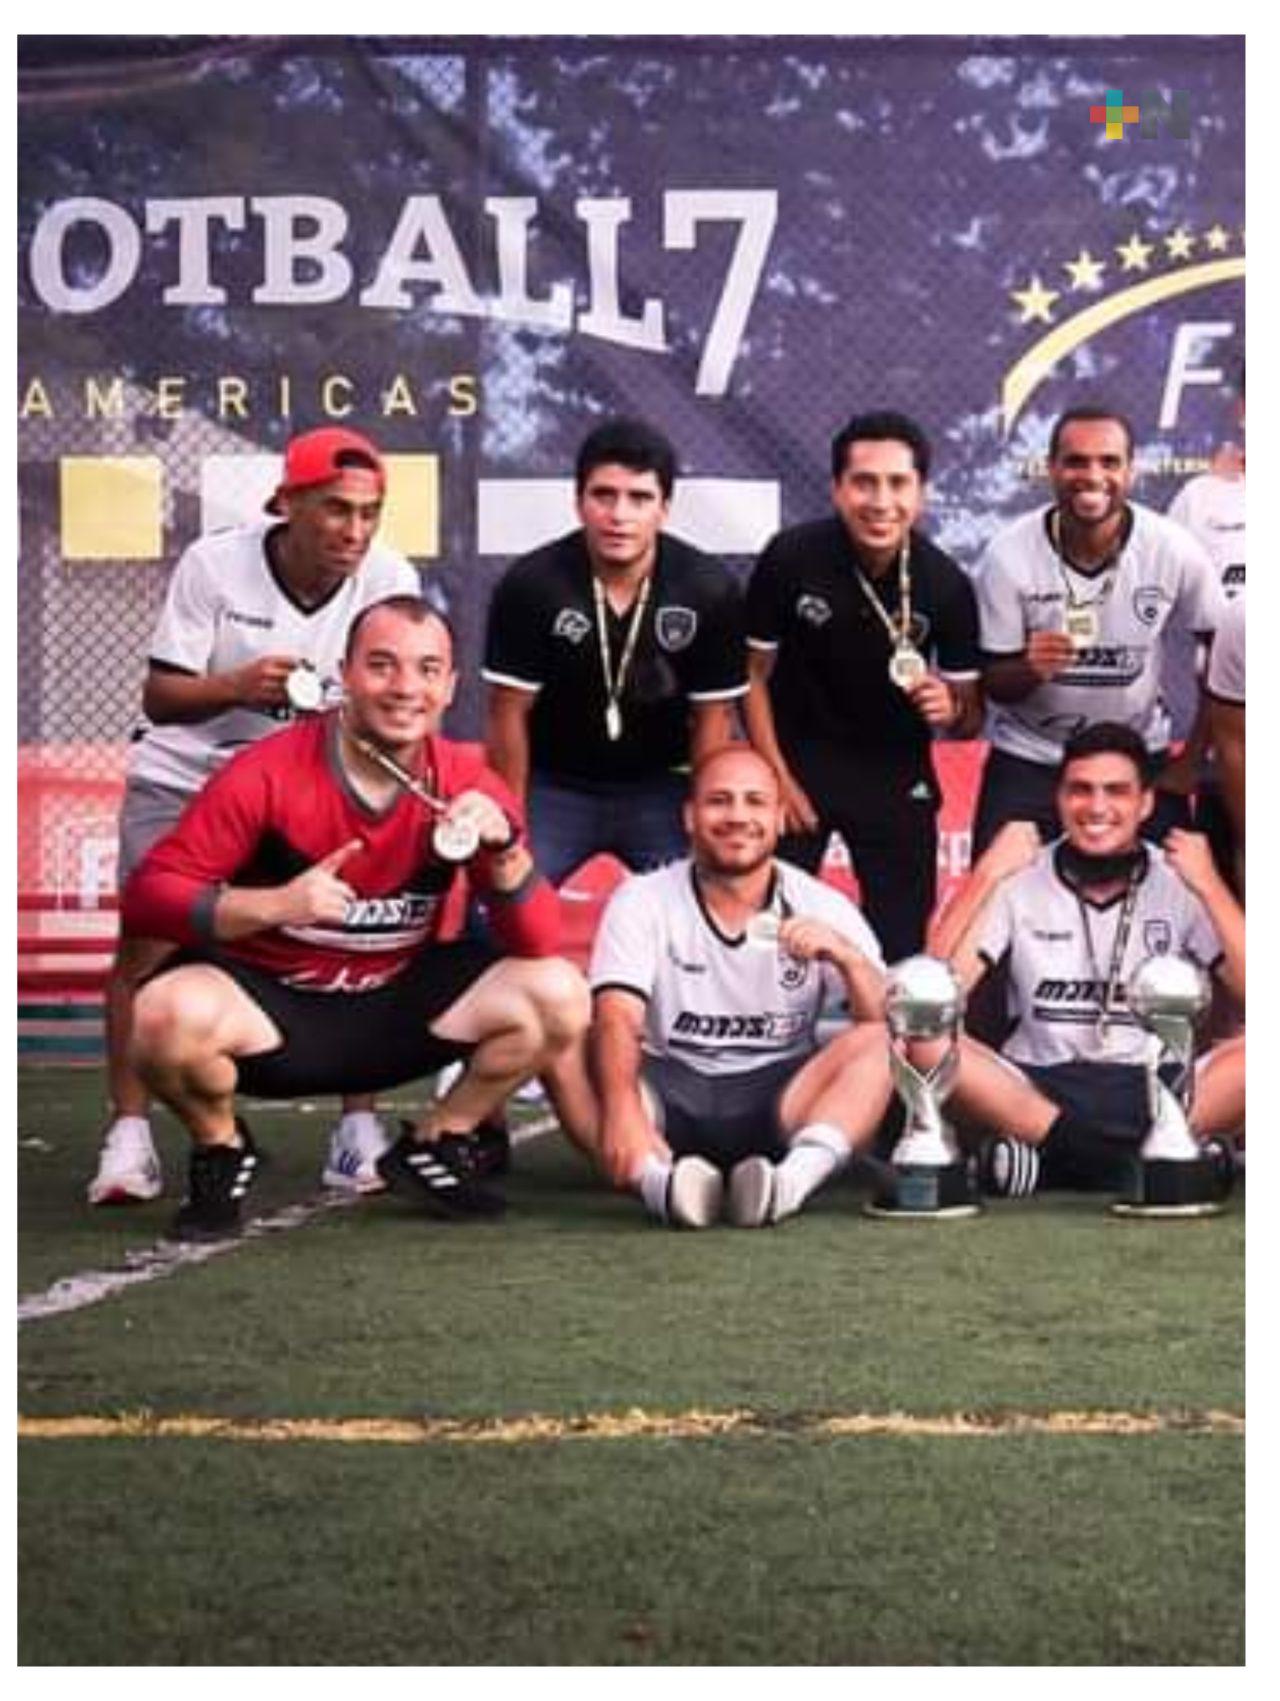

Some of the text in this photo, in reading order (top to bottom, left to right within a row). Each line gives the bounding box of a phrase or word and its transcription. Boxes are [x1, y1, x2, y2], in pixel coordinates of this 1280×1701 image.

[30, 190, 778, 397] OTBALL 7
[20, 375, 481, 418] AMERICAS
